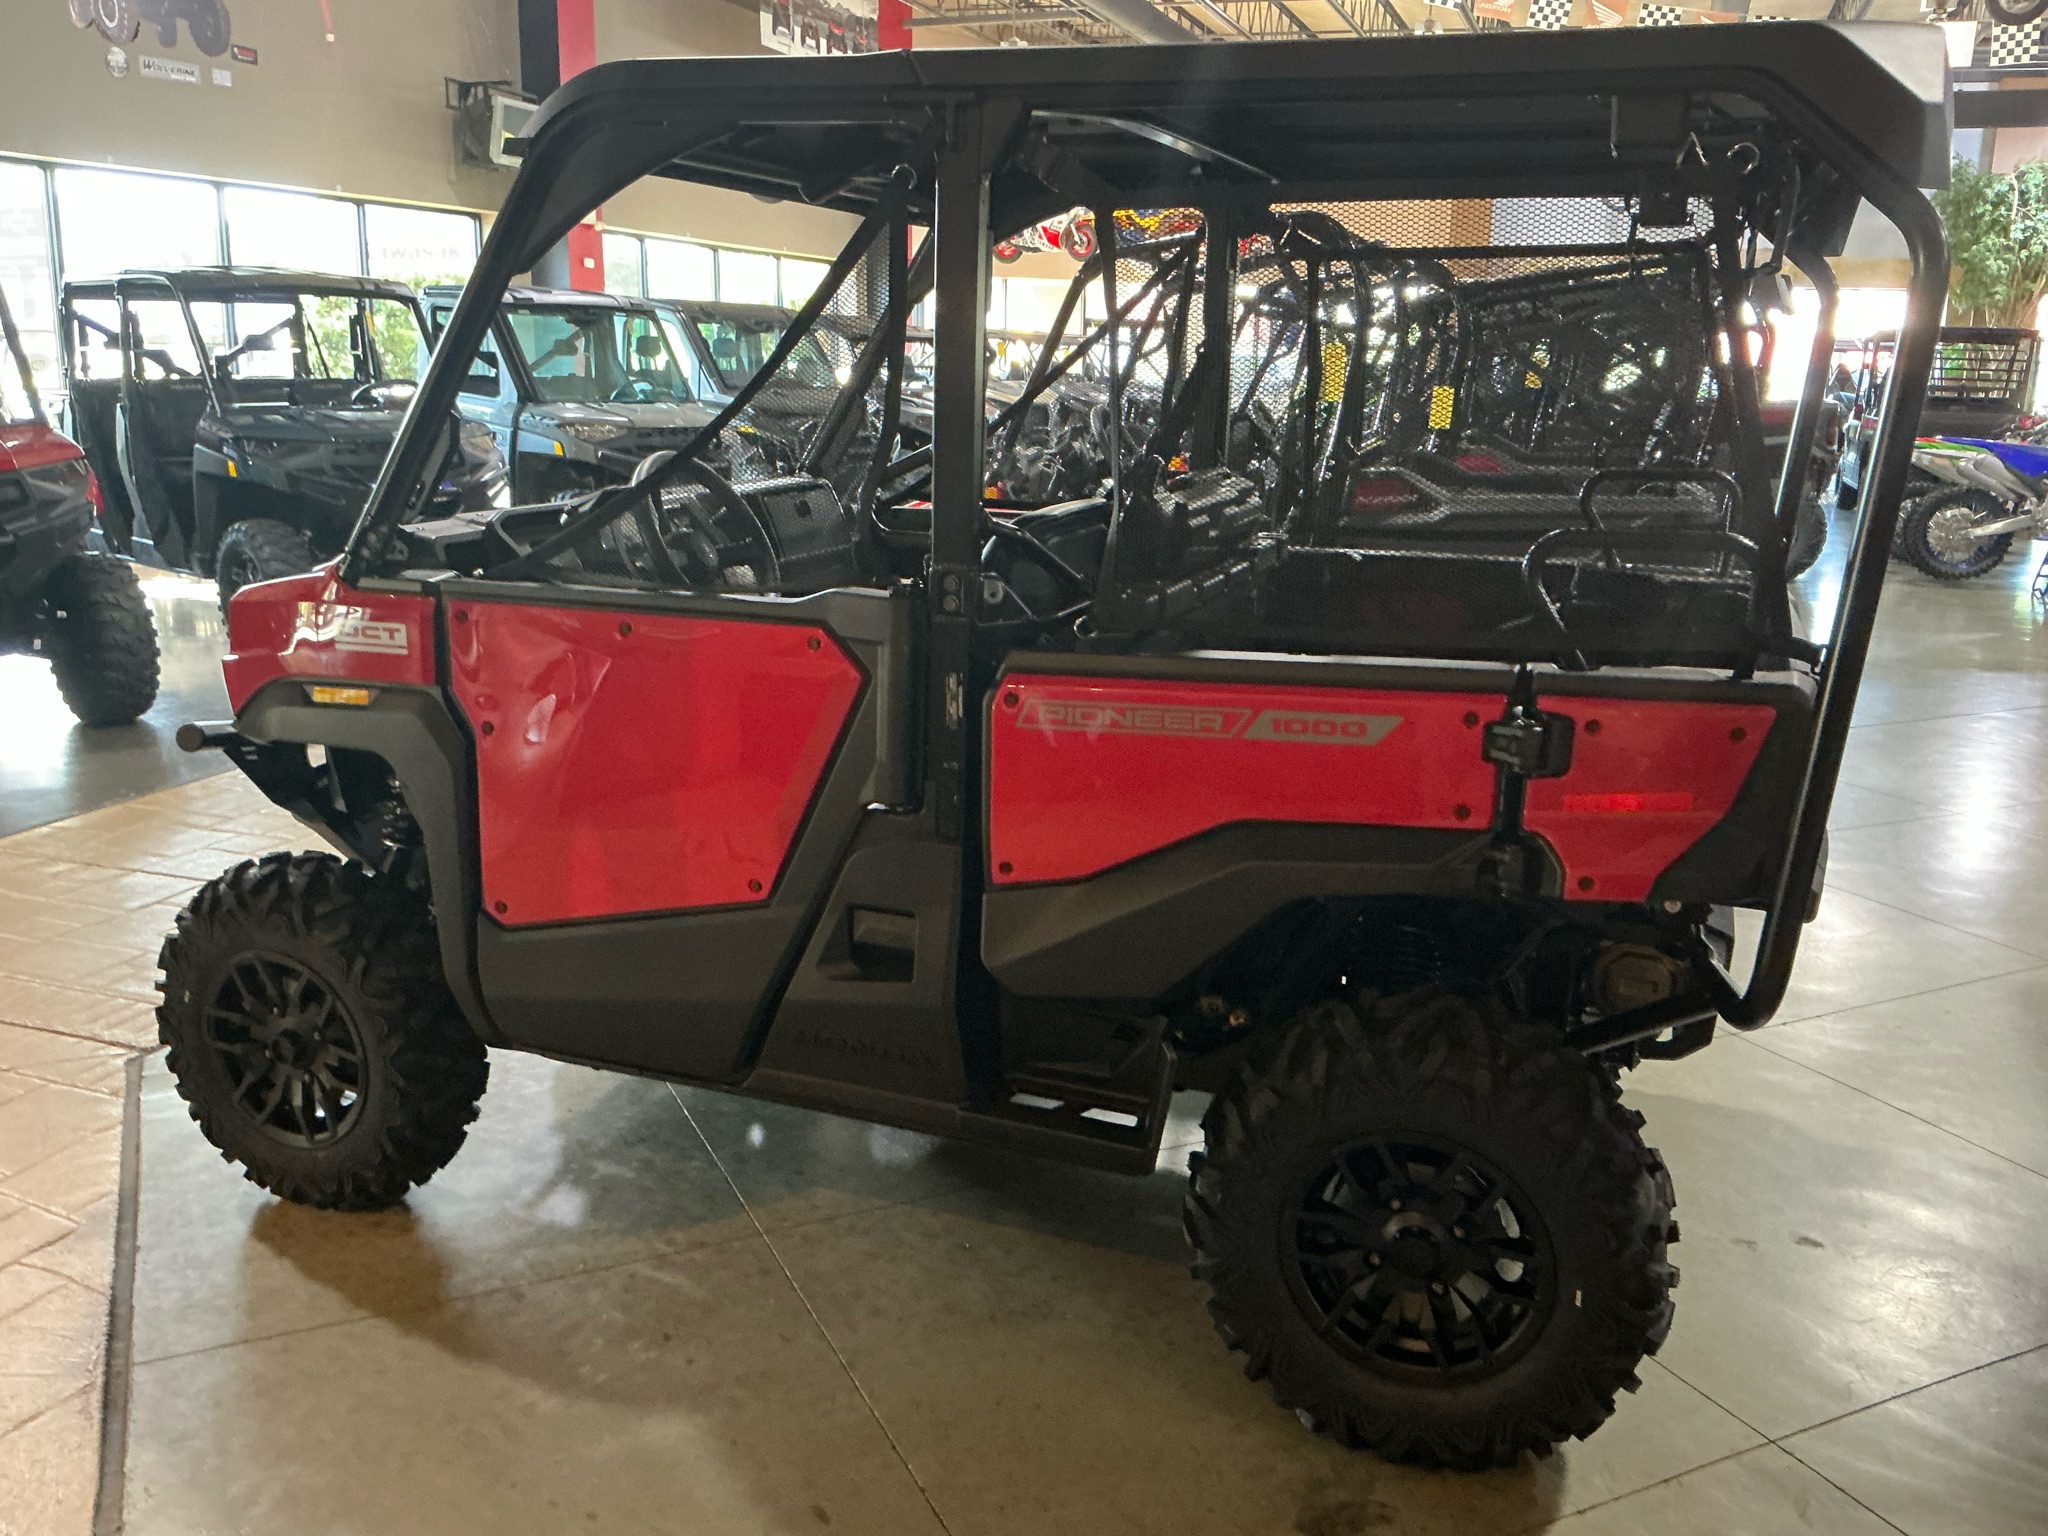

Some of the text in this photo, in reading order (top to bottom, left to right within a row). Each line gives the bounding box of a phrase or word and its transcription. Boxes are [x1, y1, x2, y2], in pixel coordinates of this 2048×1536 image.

[142, 58, 197, 77] WOLVERINE
[1038, 705, 1369, 738] PIONEER 1000
